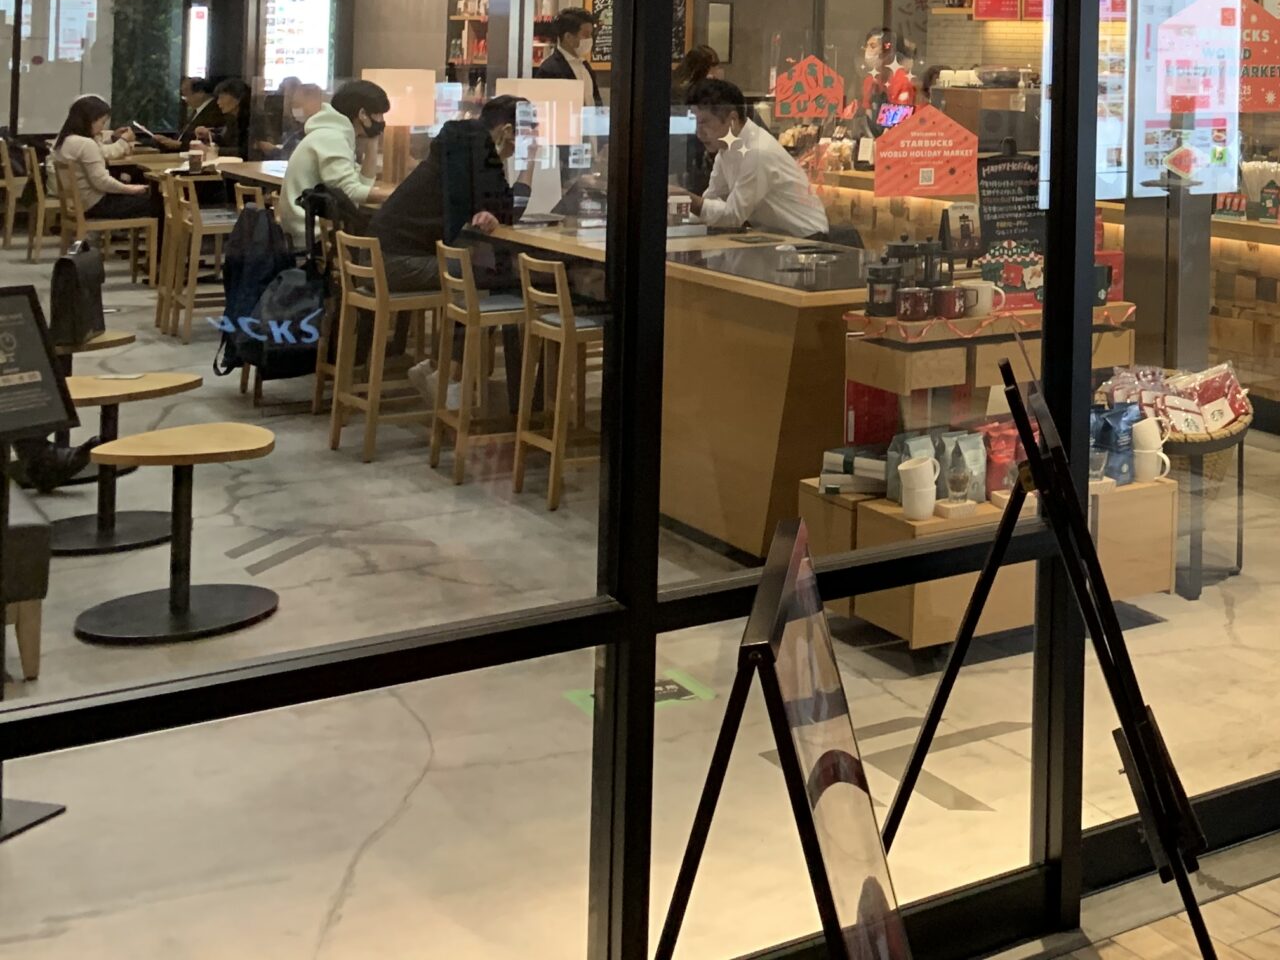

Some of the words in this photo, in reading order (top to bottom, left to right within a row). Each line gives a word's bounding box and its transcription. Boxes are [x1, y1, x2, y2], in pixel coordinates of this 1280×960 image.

[899, 139, 954, 148] STARBUCKS
[880, 151, 908, 159] WORLD
[909, 150, 941, 158] HOLIDAY
[943, 149, 974, 157] MARKET
